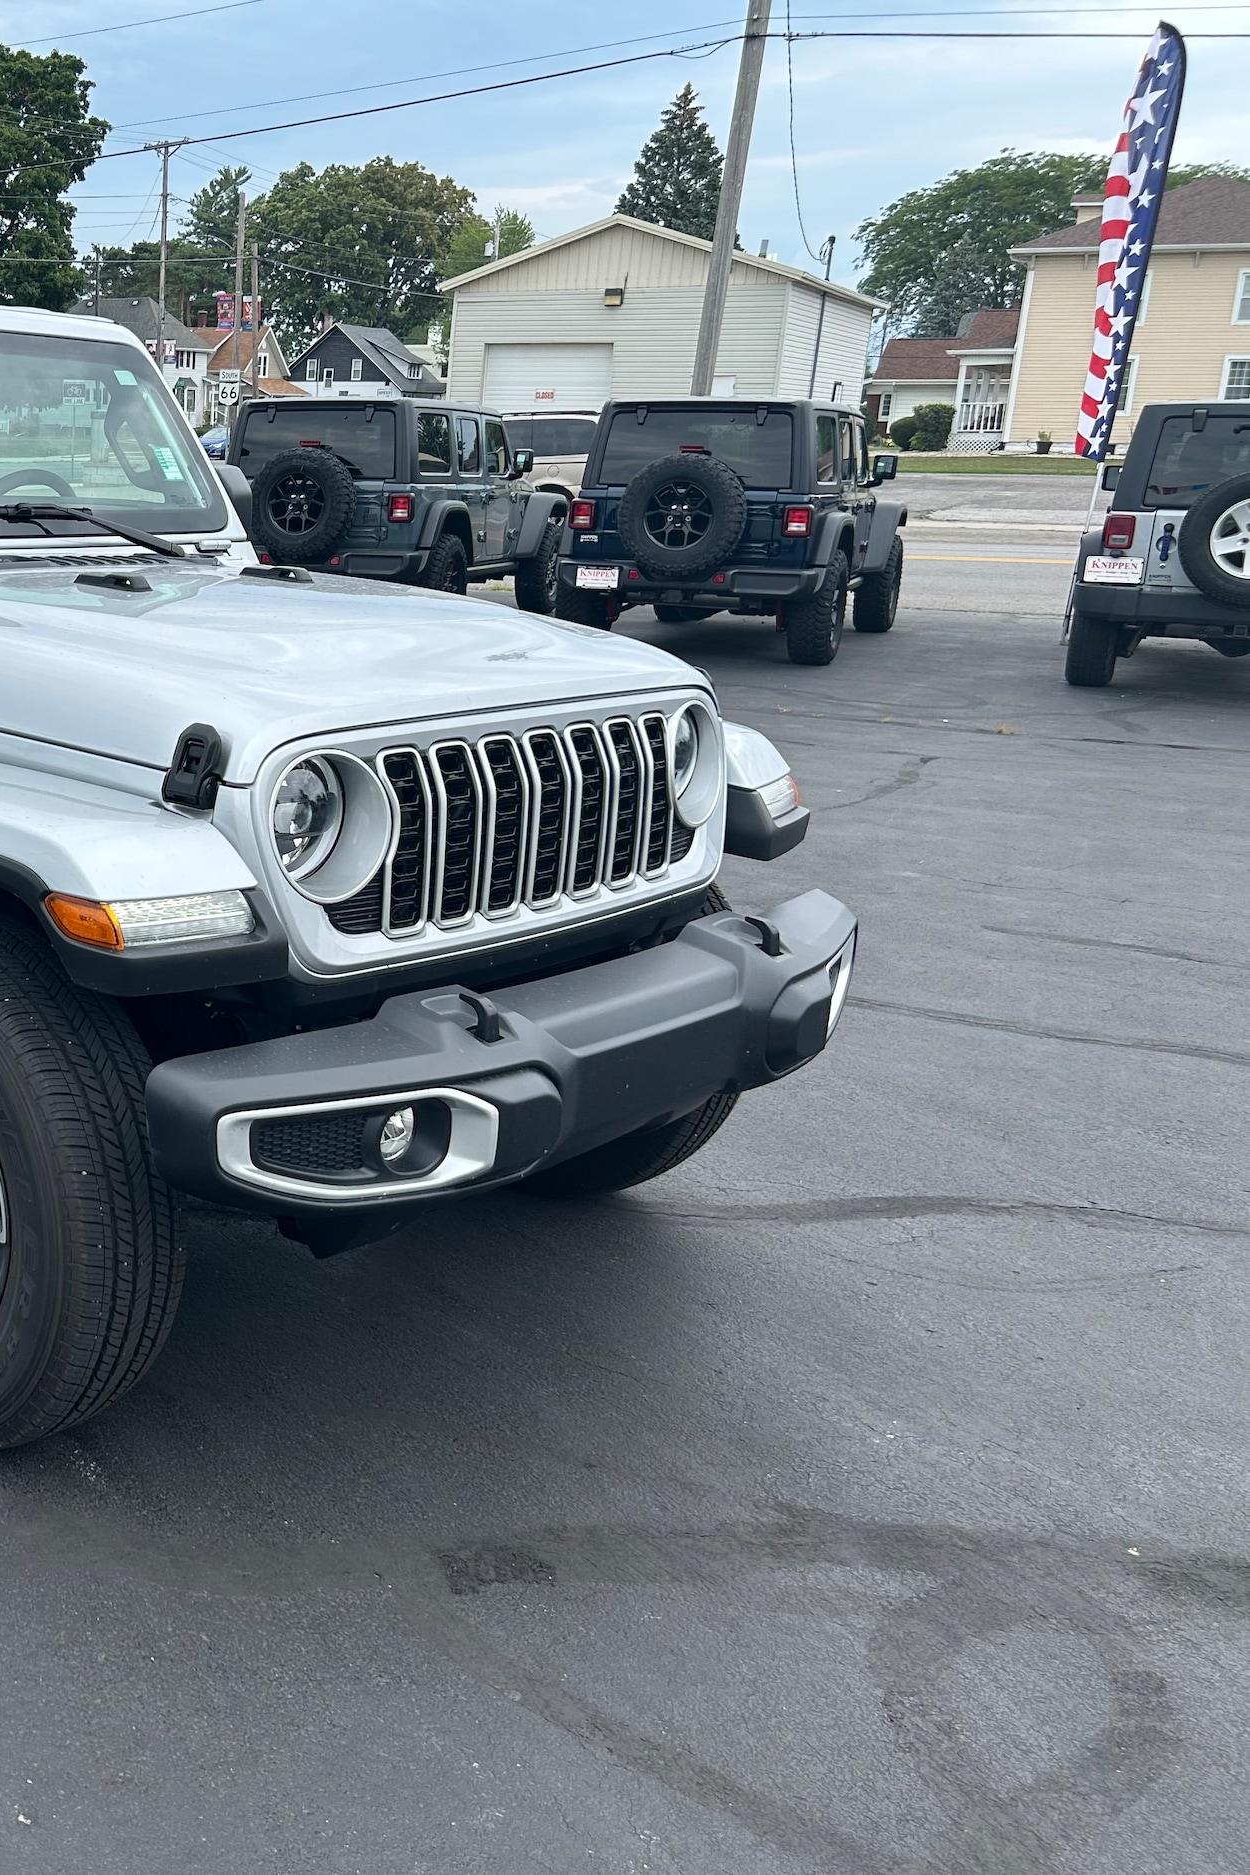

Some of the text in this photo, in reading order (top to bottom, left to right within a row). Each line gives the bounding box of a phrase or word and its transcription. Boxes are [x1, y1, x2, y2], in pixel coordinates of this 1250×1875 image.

[221, 370, 239, 379] SOUTH
[220, 386, 237, 399] 66
[535, 391, 554, 399] CLOSED
[1092, 560, 1138, 570] KNIPPEN
[580, 569, 616, 578] KNIPPEN
